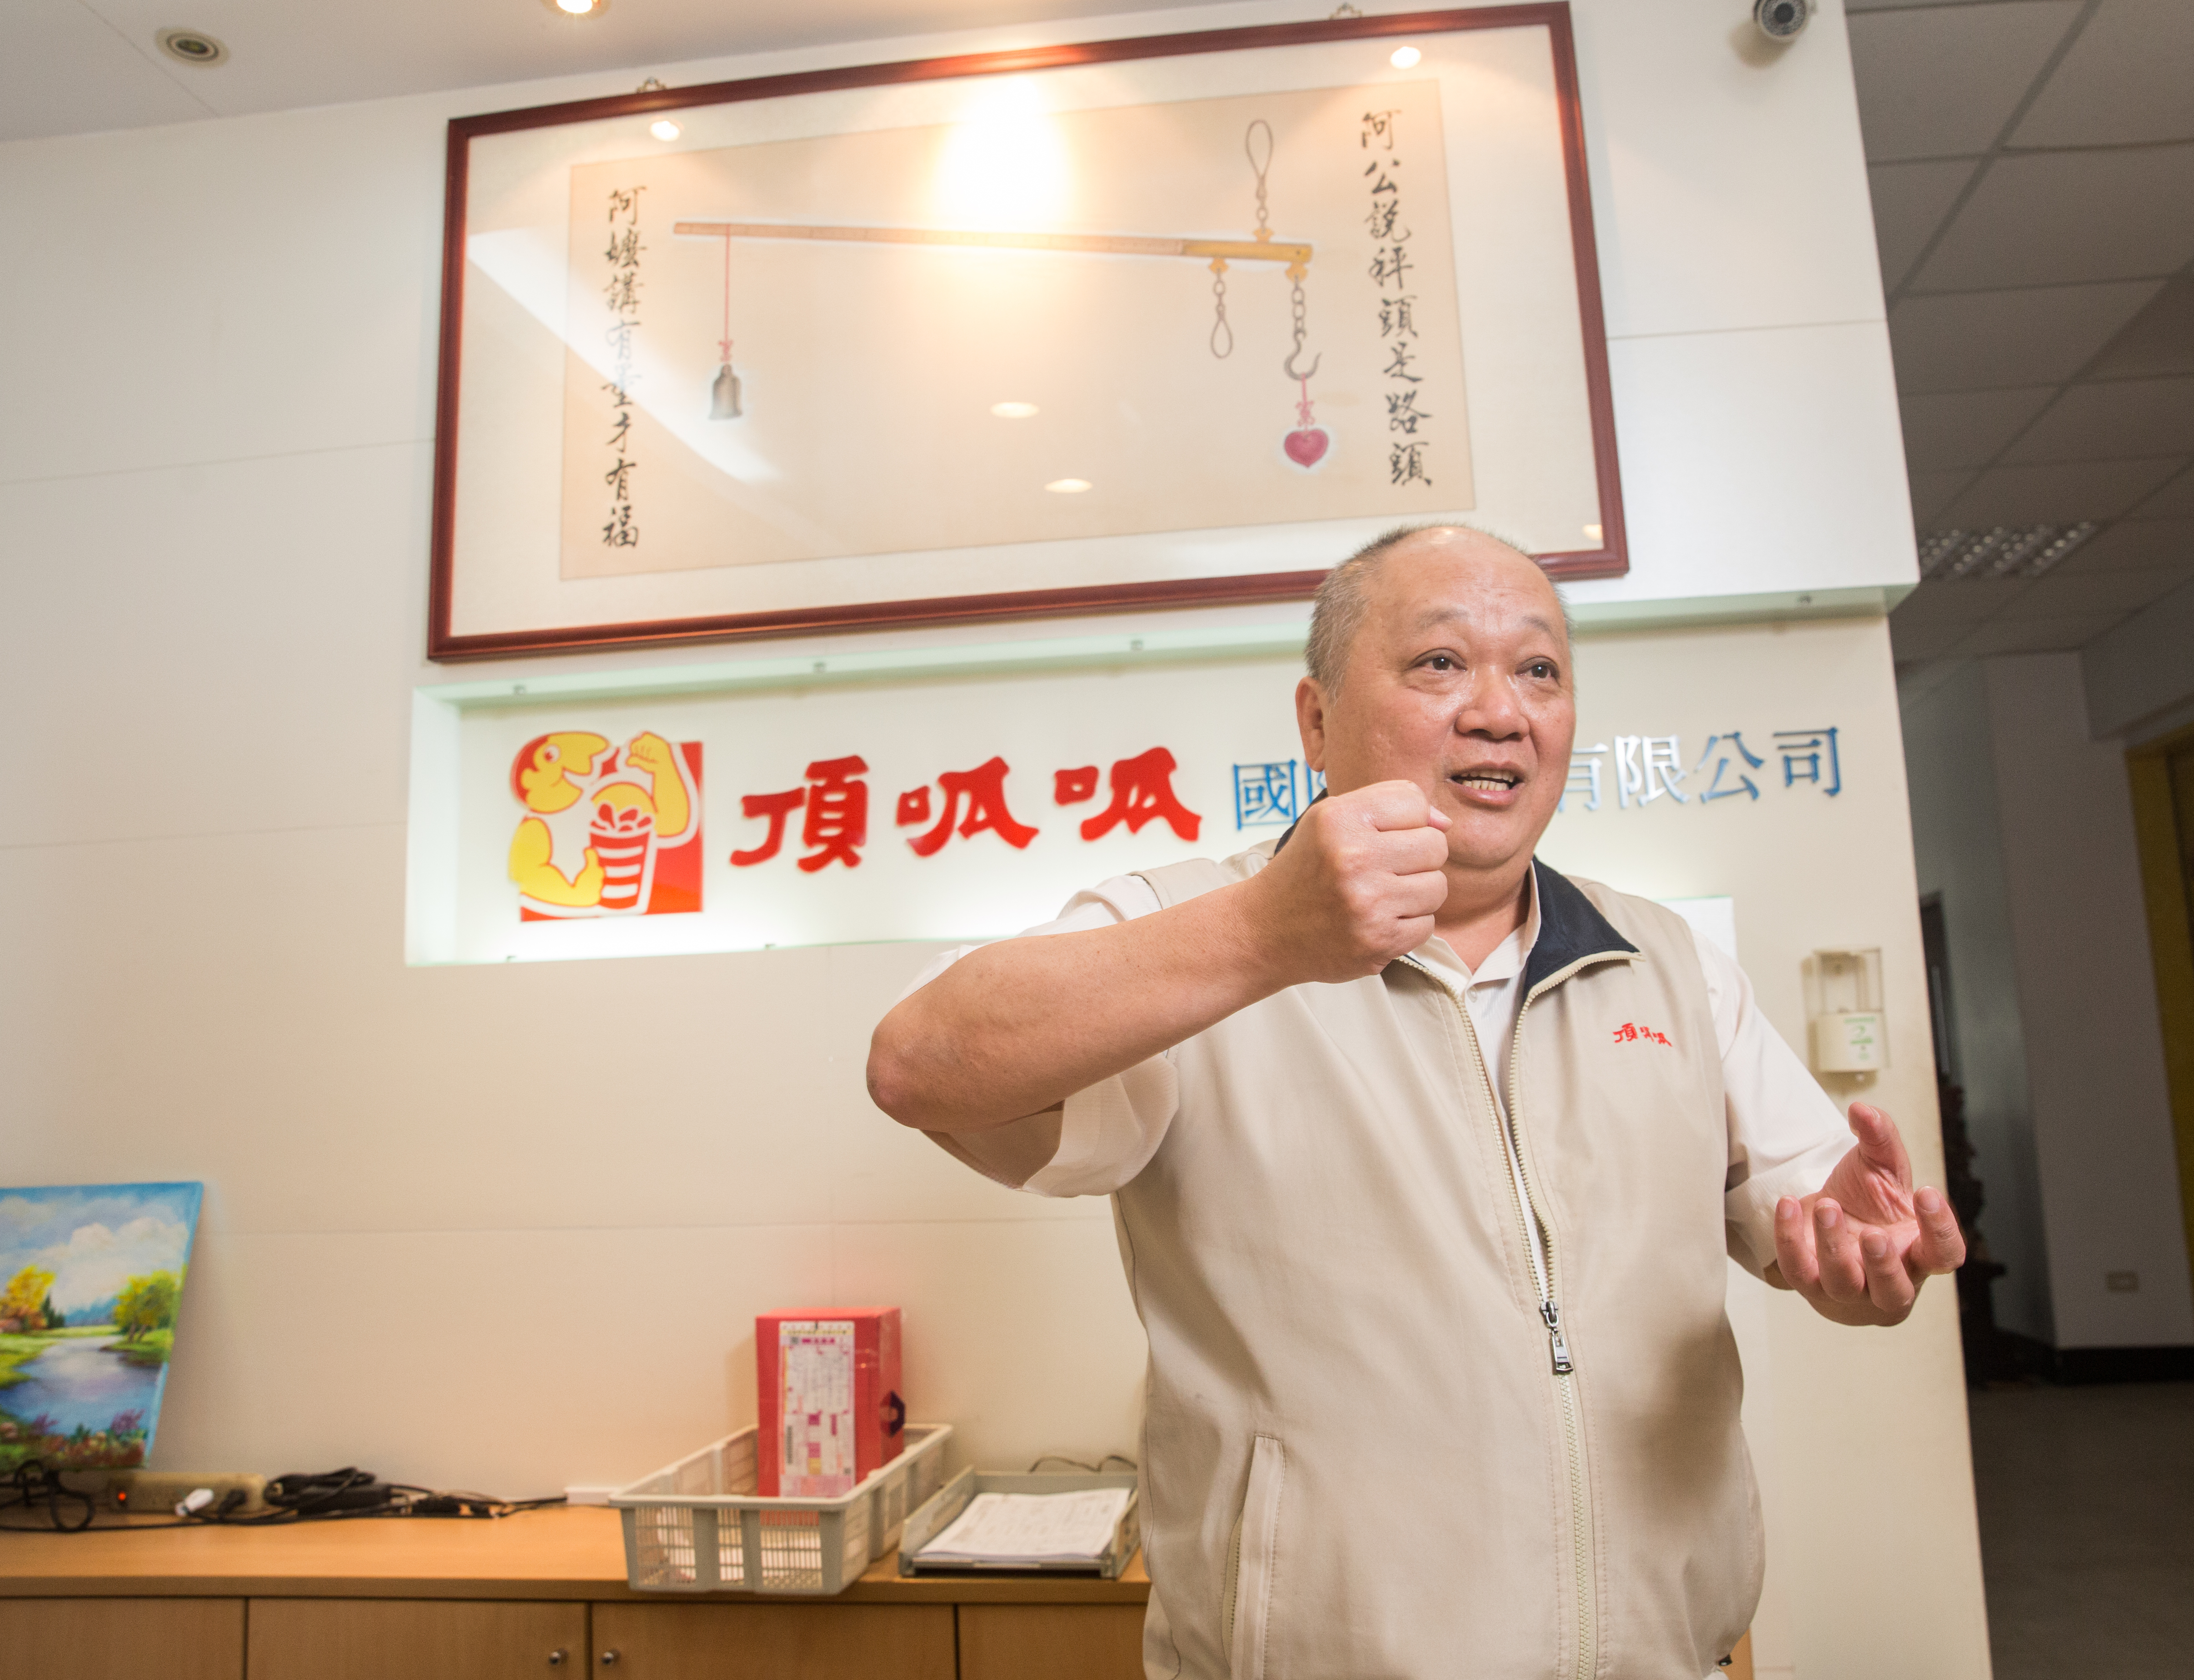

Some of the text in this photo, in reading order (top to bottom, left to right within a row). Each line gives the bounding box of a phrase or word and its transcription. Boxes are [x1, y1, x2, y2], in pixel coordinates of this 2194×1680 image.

[1361, 110, 1432, 487] 阿公說秤頭是路頭
[729, 747, 1202, 873] 頂呱呱
